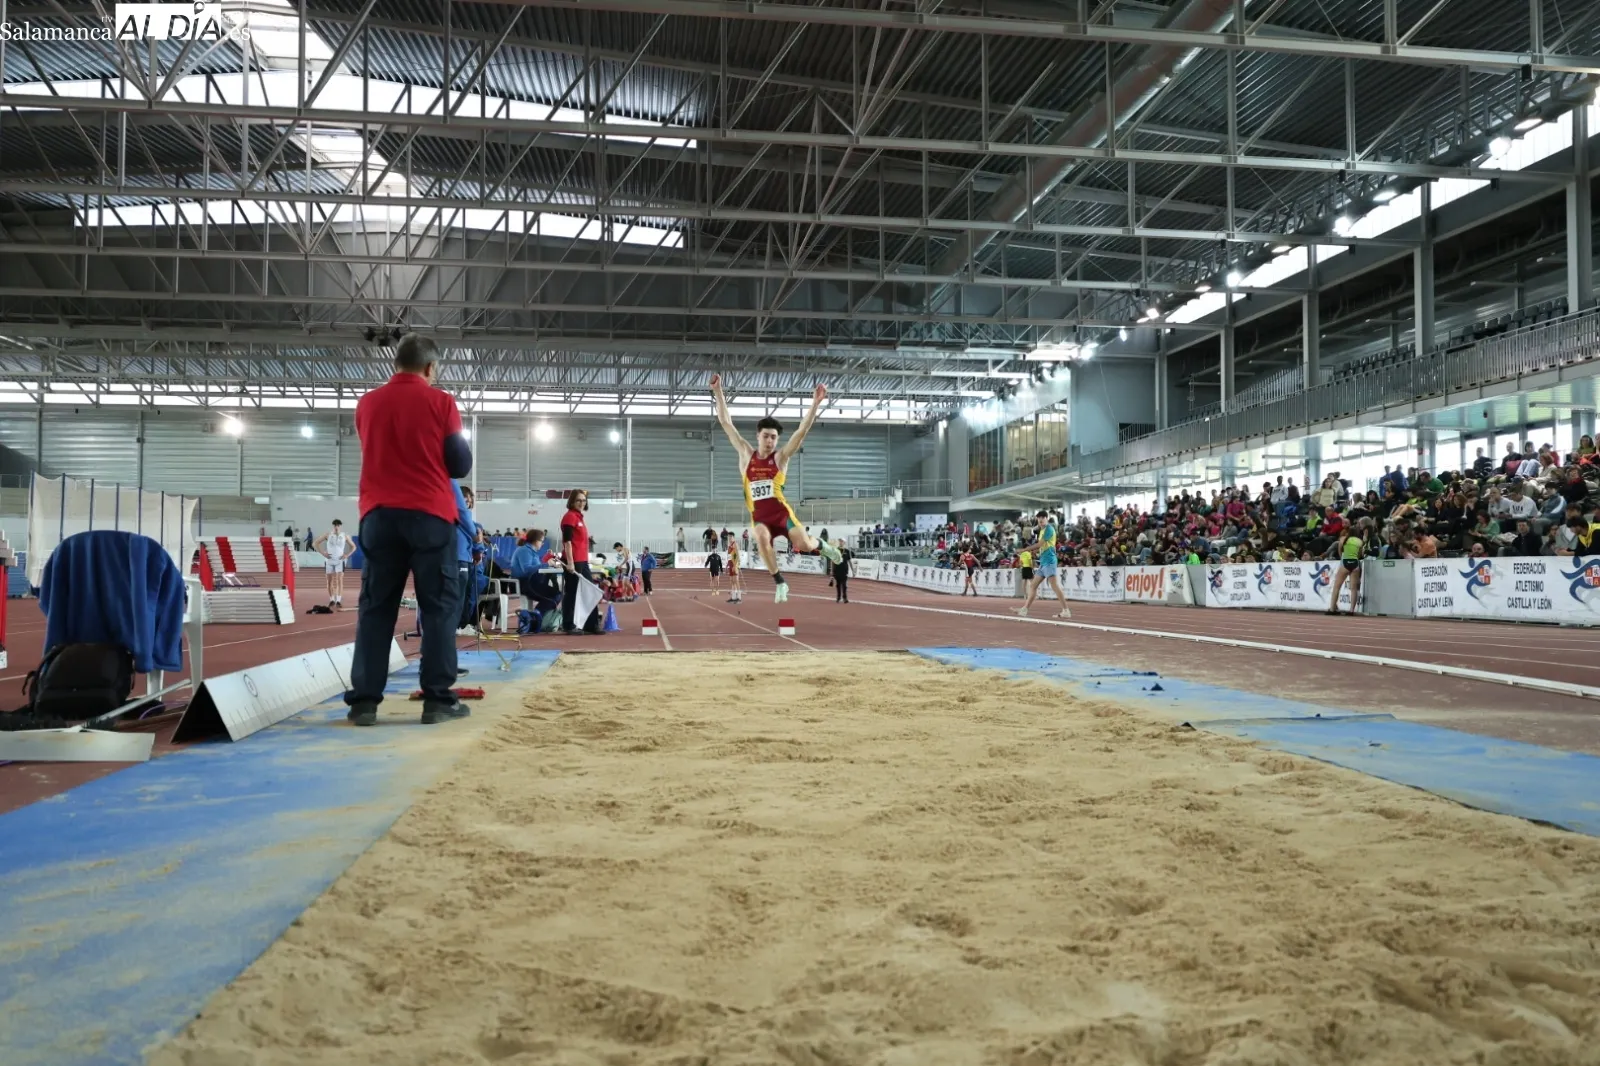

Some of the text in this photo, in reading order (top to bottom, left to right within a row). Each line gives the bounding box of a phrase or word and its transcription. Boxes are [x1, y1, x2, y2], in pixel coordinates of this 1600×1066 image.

[751, 485, 771, 498] 3937
[1421, 564, 1448, 576] FEDERACIÓN
[1513, 560, 1546, 575] FEDERACIÓN
[1126, 567, 1164, 599] enjoy!
[1423, 581, 1447, 593] ATLETISMO
[1515, 580, 1544, 592] ATLETISMO
[1418, 597, 1437, 608] CASTILLA
[1507, 596, 1552, 610] CASTILLA Y LEÓN
